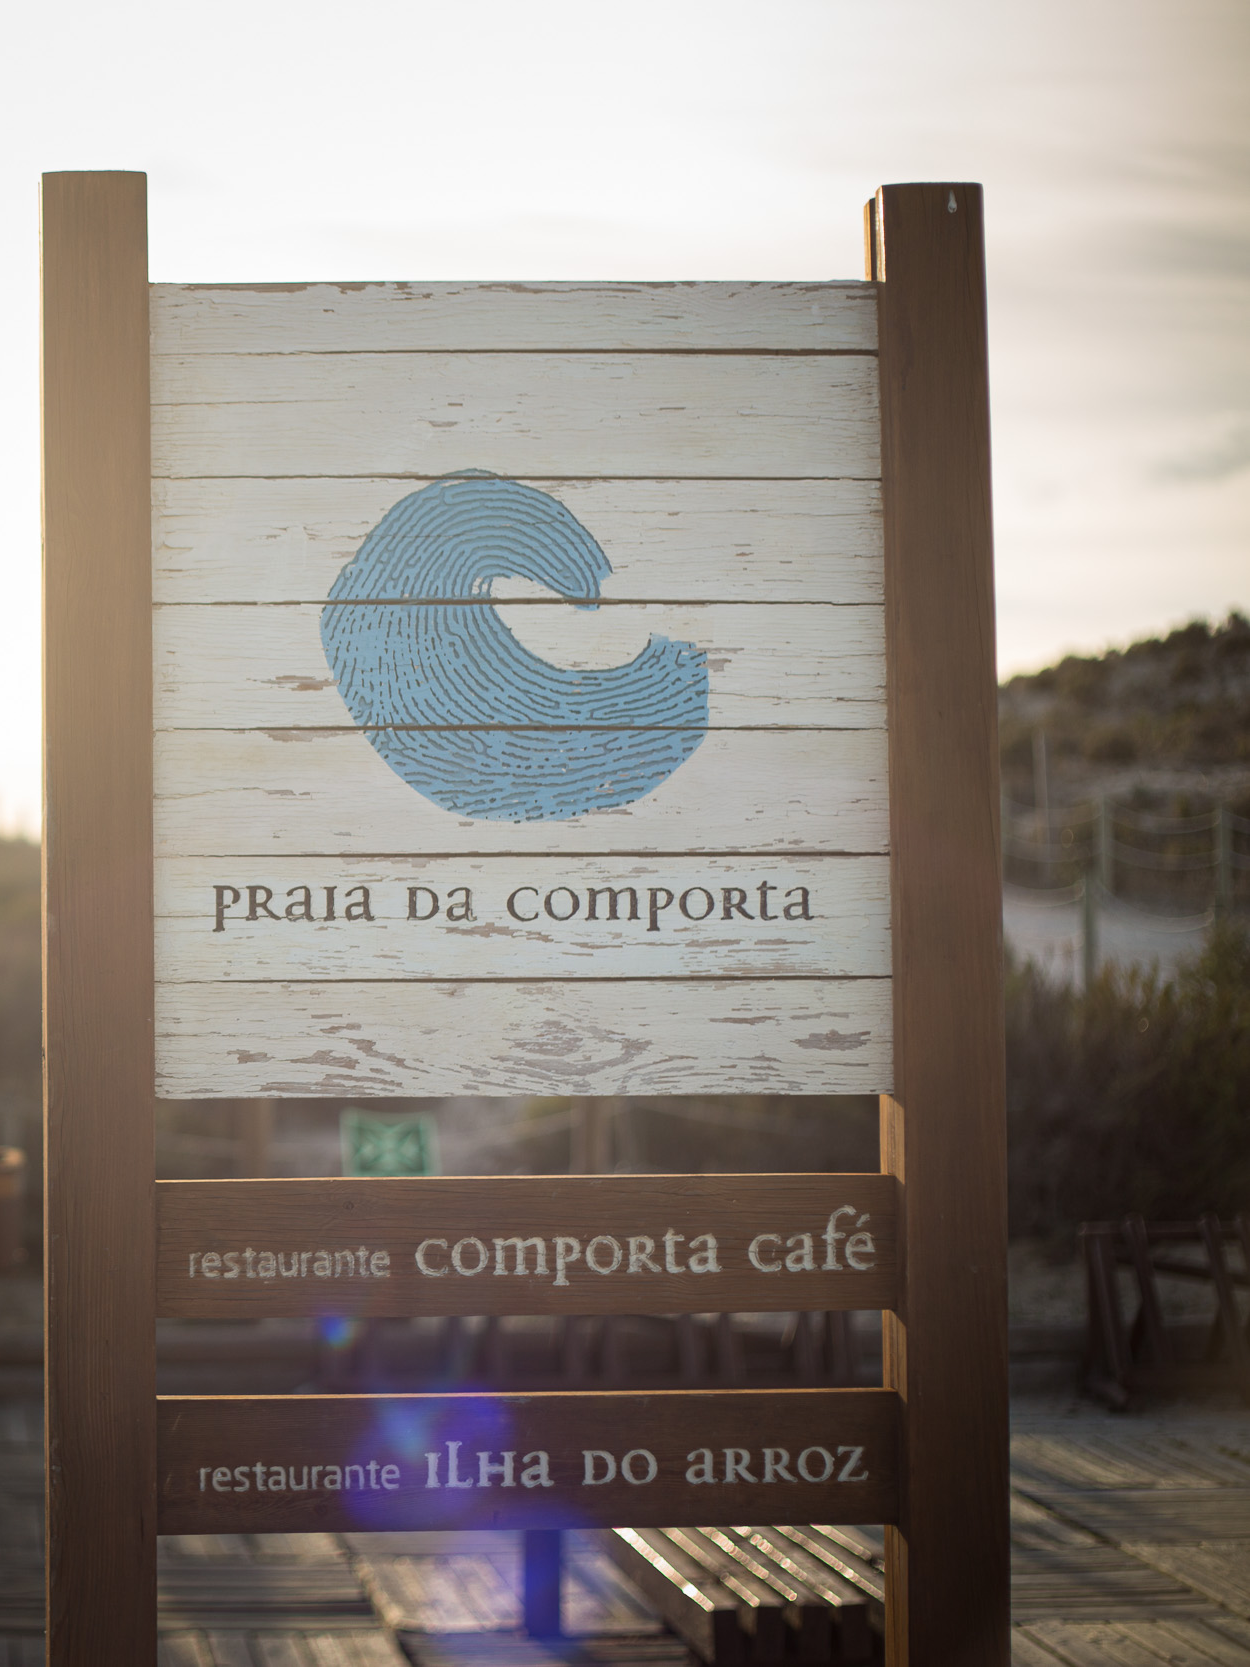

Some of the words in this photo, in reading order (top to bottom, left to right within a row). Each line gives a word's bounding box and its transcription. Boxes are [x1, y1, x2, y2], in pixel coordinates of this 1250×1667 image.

[187, 1244, 392, 1279] restaurante
[748, 1204, 878, 1273] café
[197, 1459, 401, 1493] restaurante
